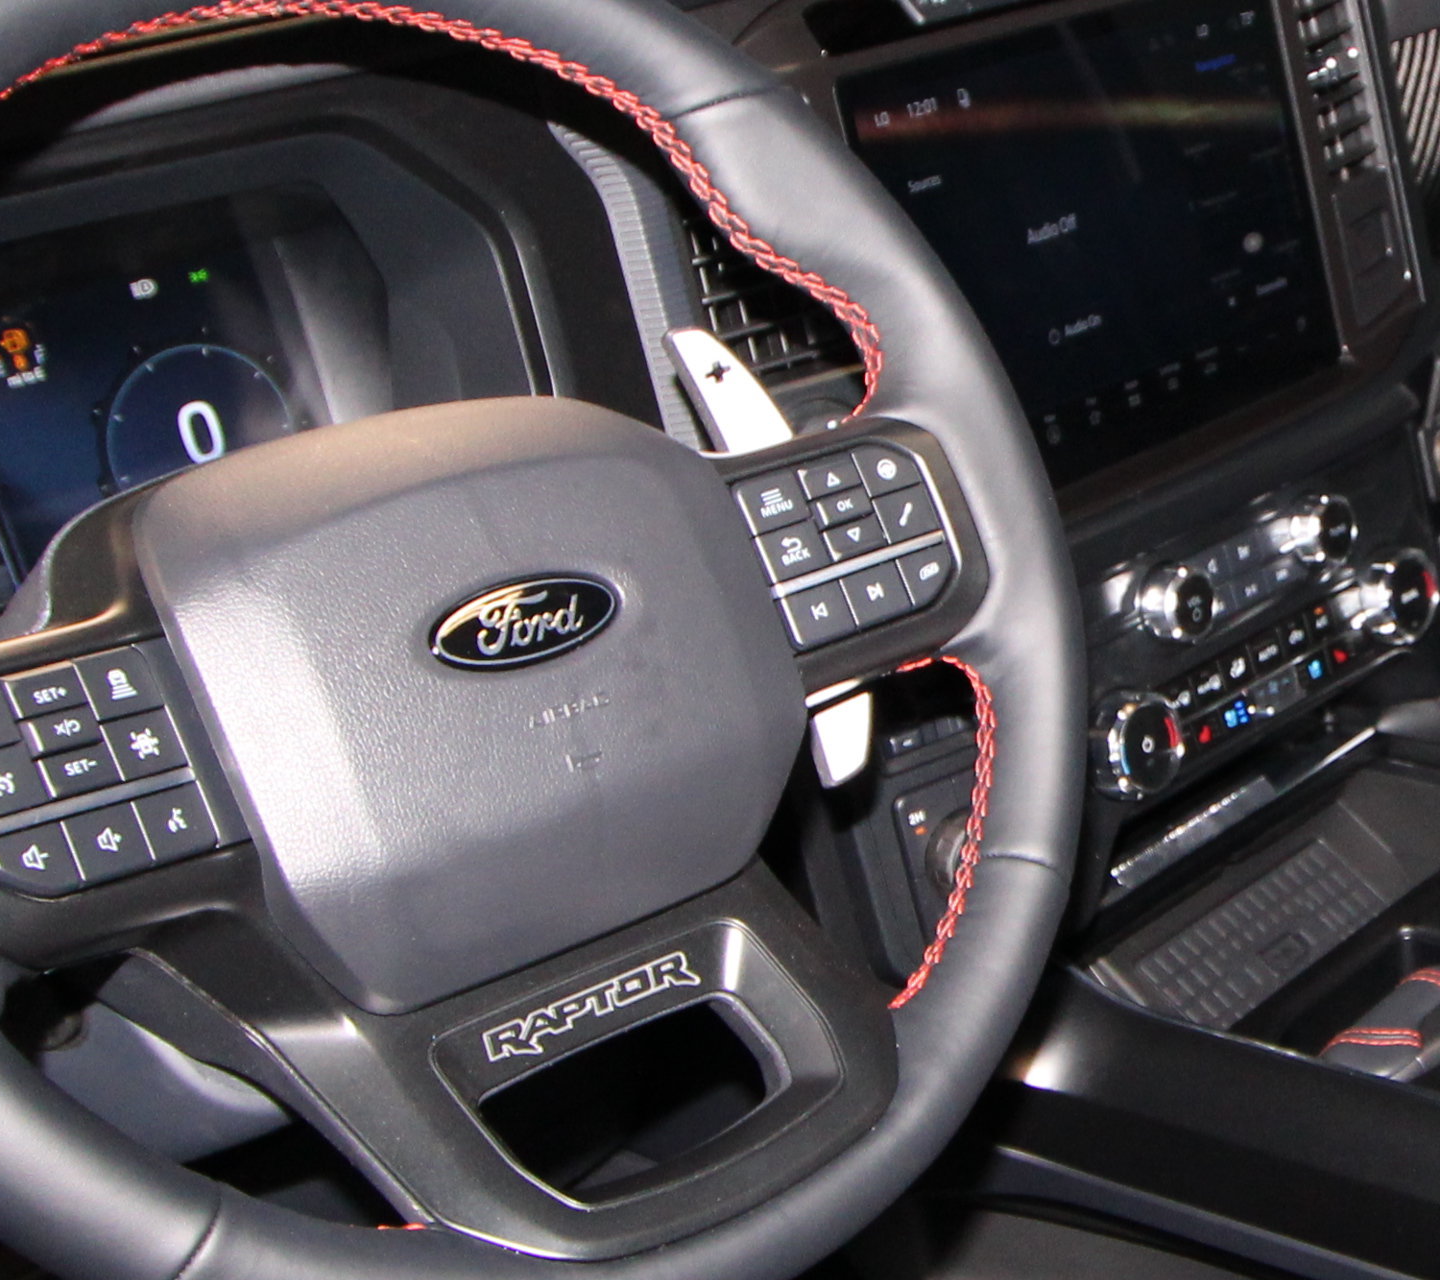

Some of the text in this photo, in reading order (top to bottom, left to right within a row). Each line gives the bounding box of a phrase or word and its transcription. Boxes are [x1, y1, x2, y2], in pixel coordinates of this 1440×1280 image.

[177, 400, 224, 465] 0
[760, 499, 793, 518] MENU
[836, 498, 854, 513] OK
[781, 548, 811, 567] BACK
[476, 590, 584, 656] Ford
[33, 686, 68, 705] SET+
[64, 759, 98, 777] SET-
[908, 810, 926, 827] 2H
[482, 951, 702, 1062] RAPTOR
